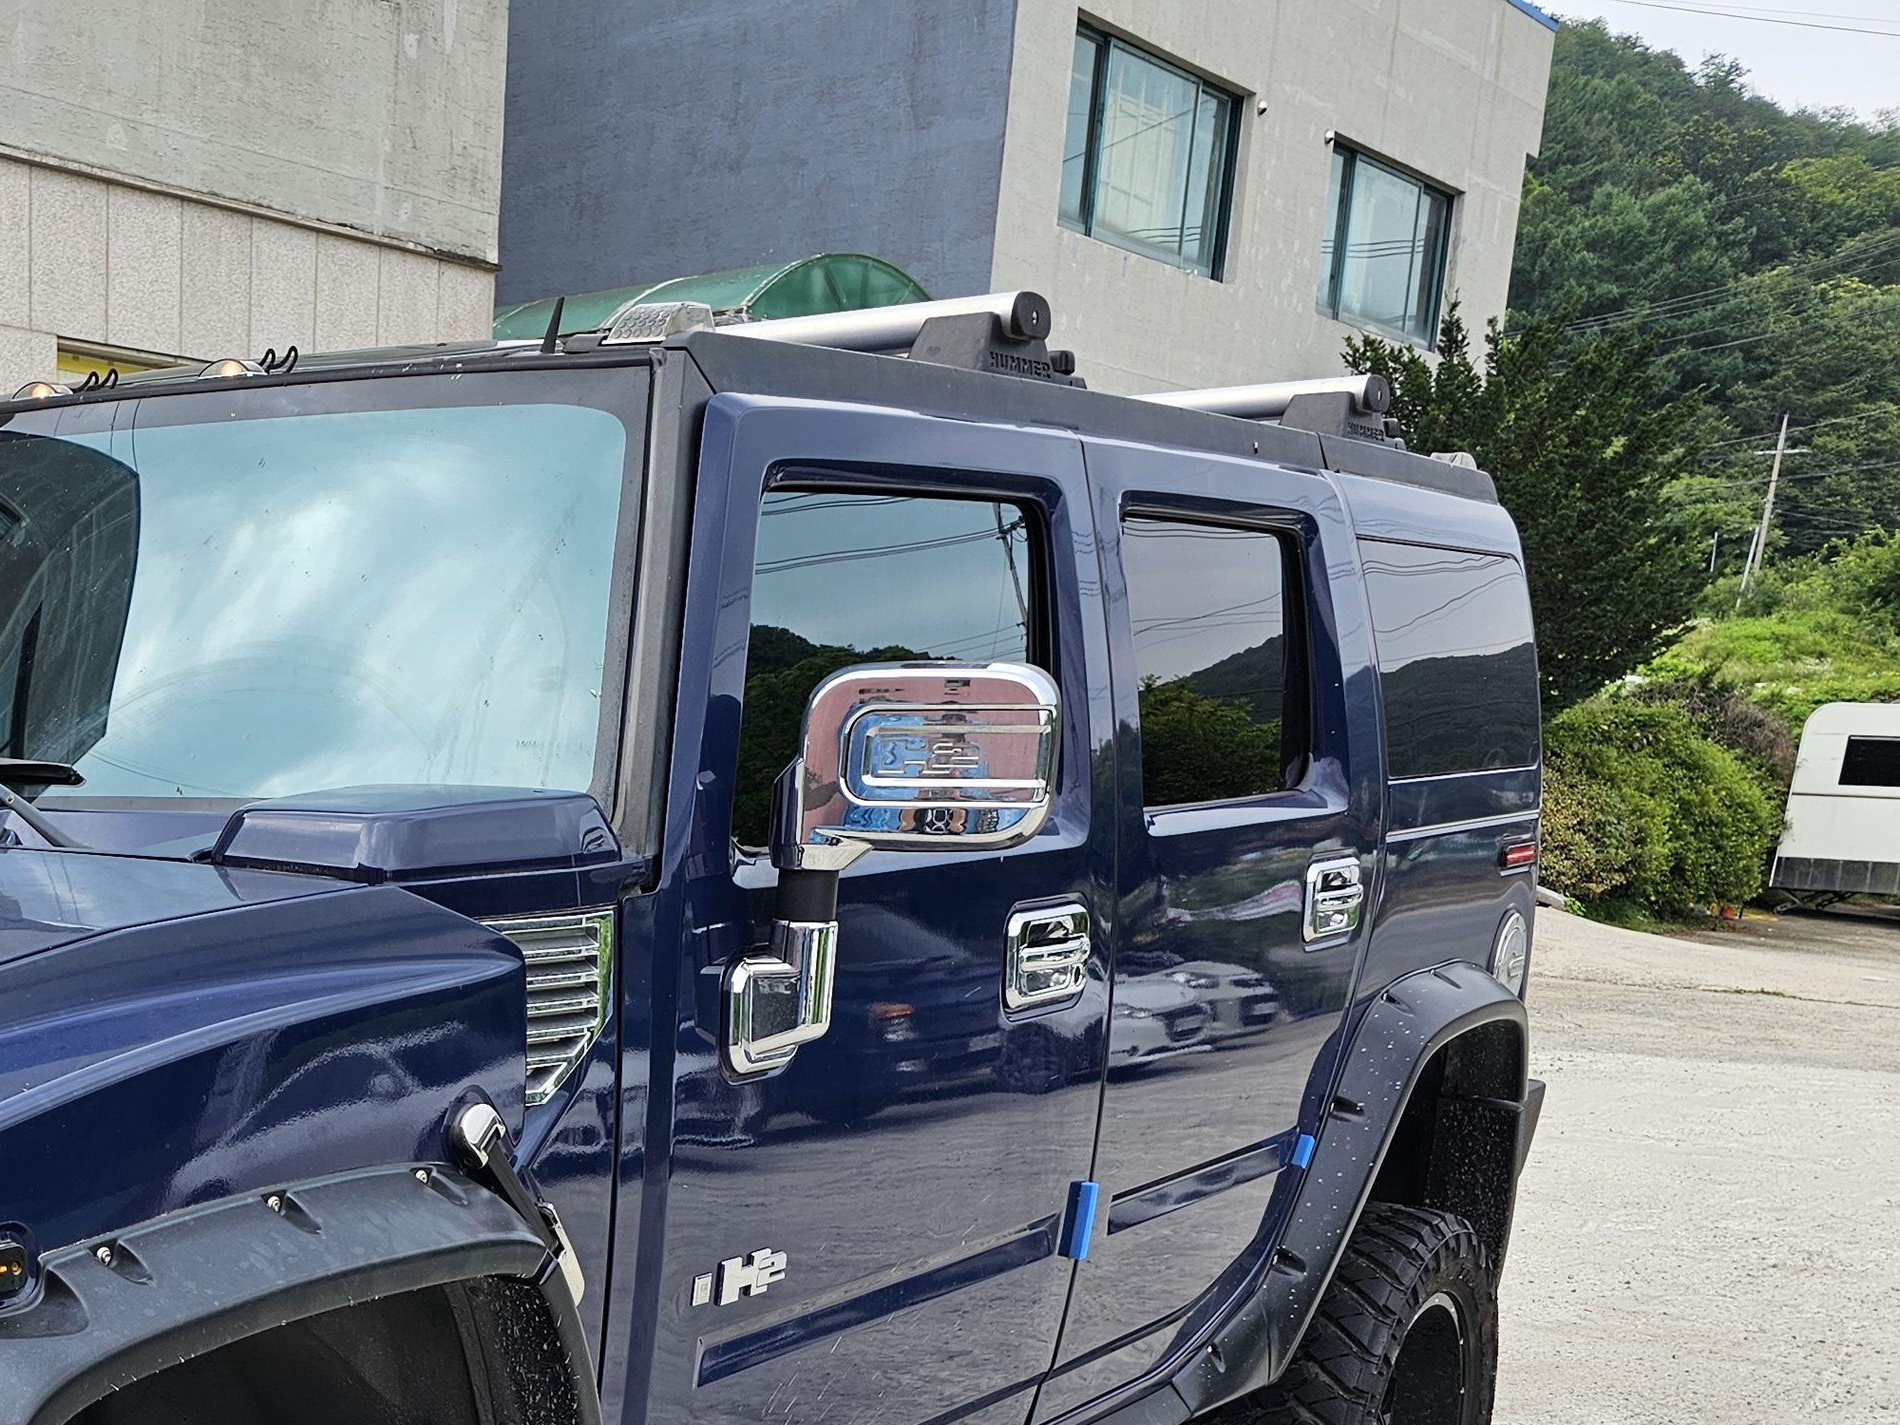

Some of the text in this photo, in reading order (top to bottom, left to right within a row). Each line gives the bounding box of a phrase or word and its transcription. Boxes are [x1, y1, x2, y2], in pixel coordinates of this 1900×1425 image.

[989, 351, 1052, 379] HUMMER
[1347, 421, 1385, 442] HUMMER
[713, 1247, 788, 1307] H2
